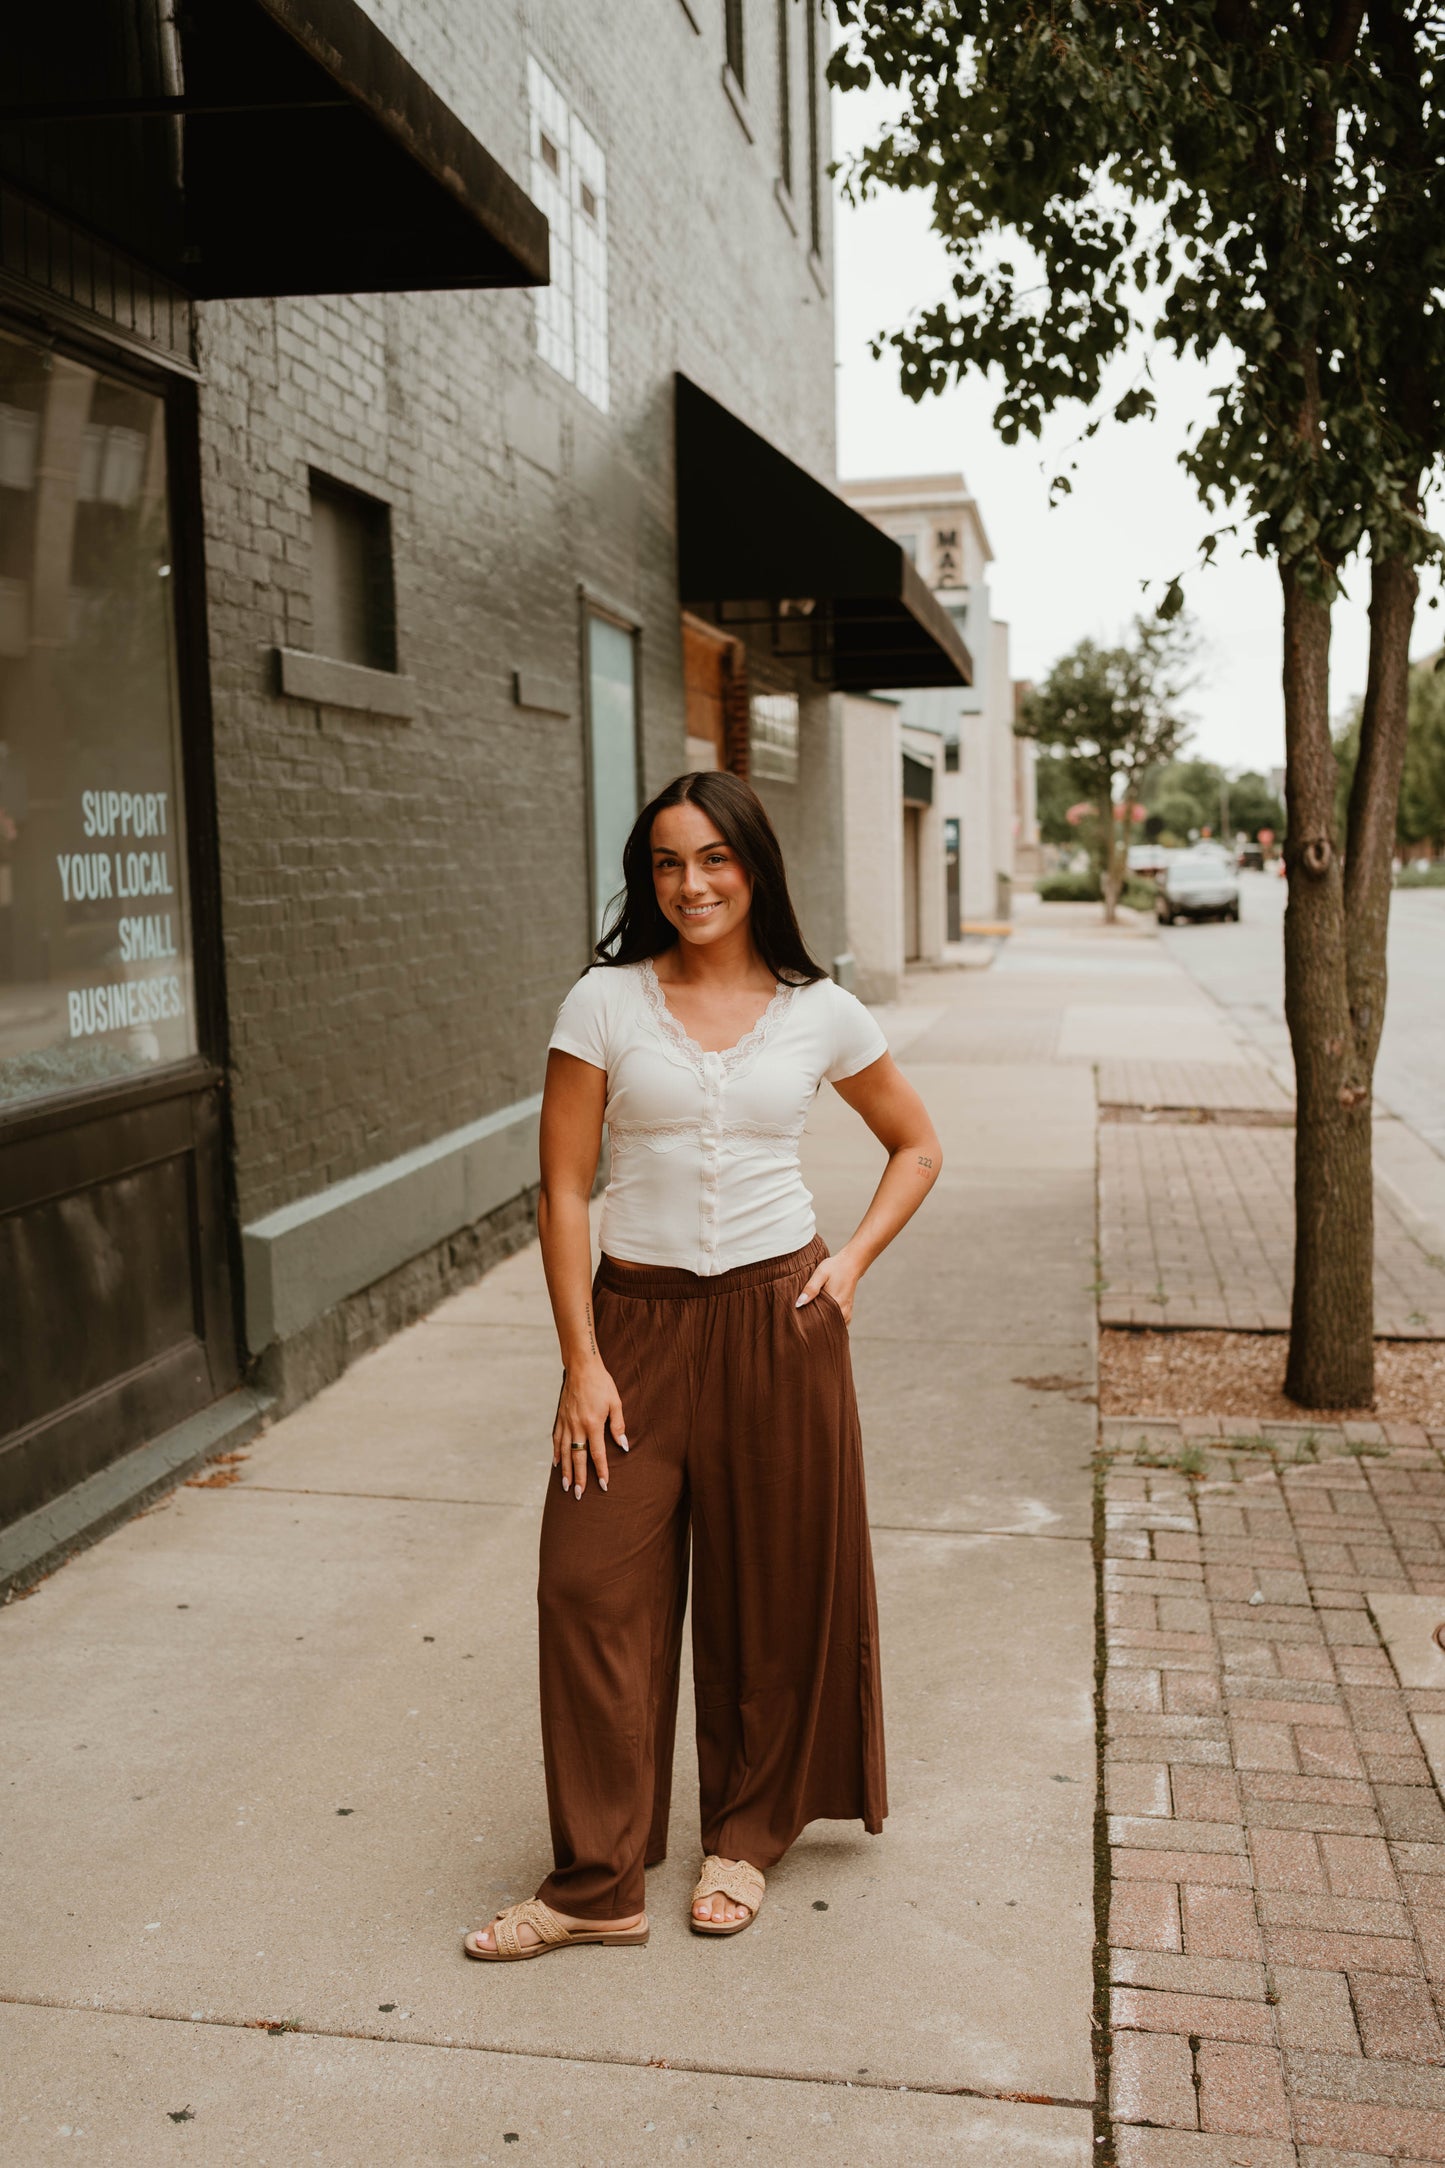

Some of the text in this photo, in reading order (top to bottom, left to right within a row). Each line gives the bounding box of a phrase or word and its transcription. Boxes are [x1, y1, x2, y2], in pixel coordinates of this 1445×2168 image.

[82, 790, 168, 838] SUPPORT
[57, 852, 173, 901] YOUR LOCAL
[119, 914, 176, 962] SMALL
[67, 976, 185, 1038] BUSINESSES.
